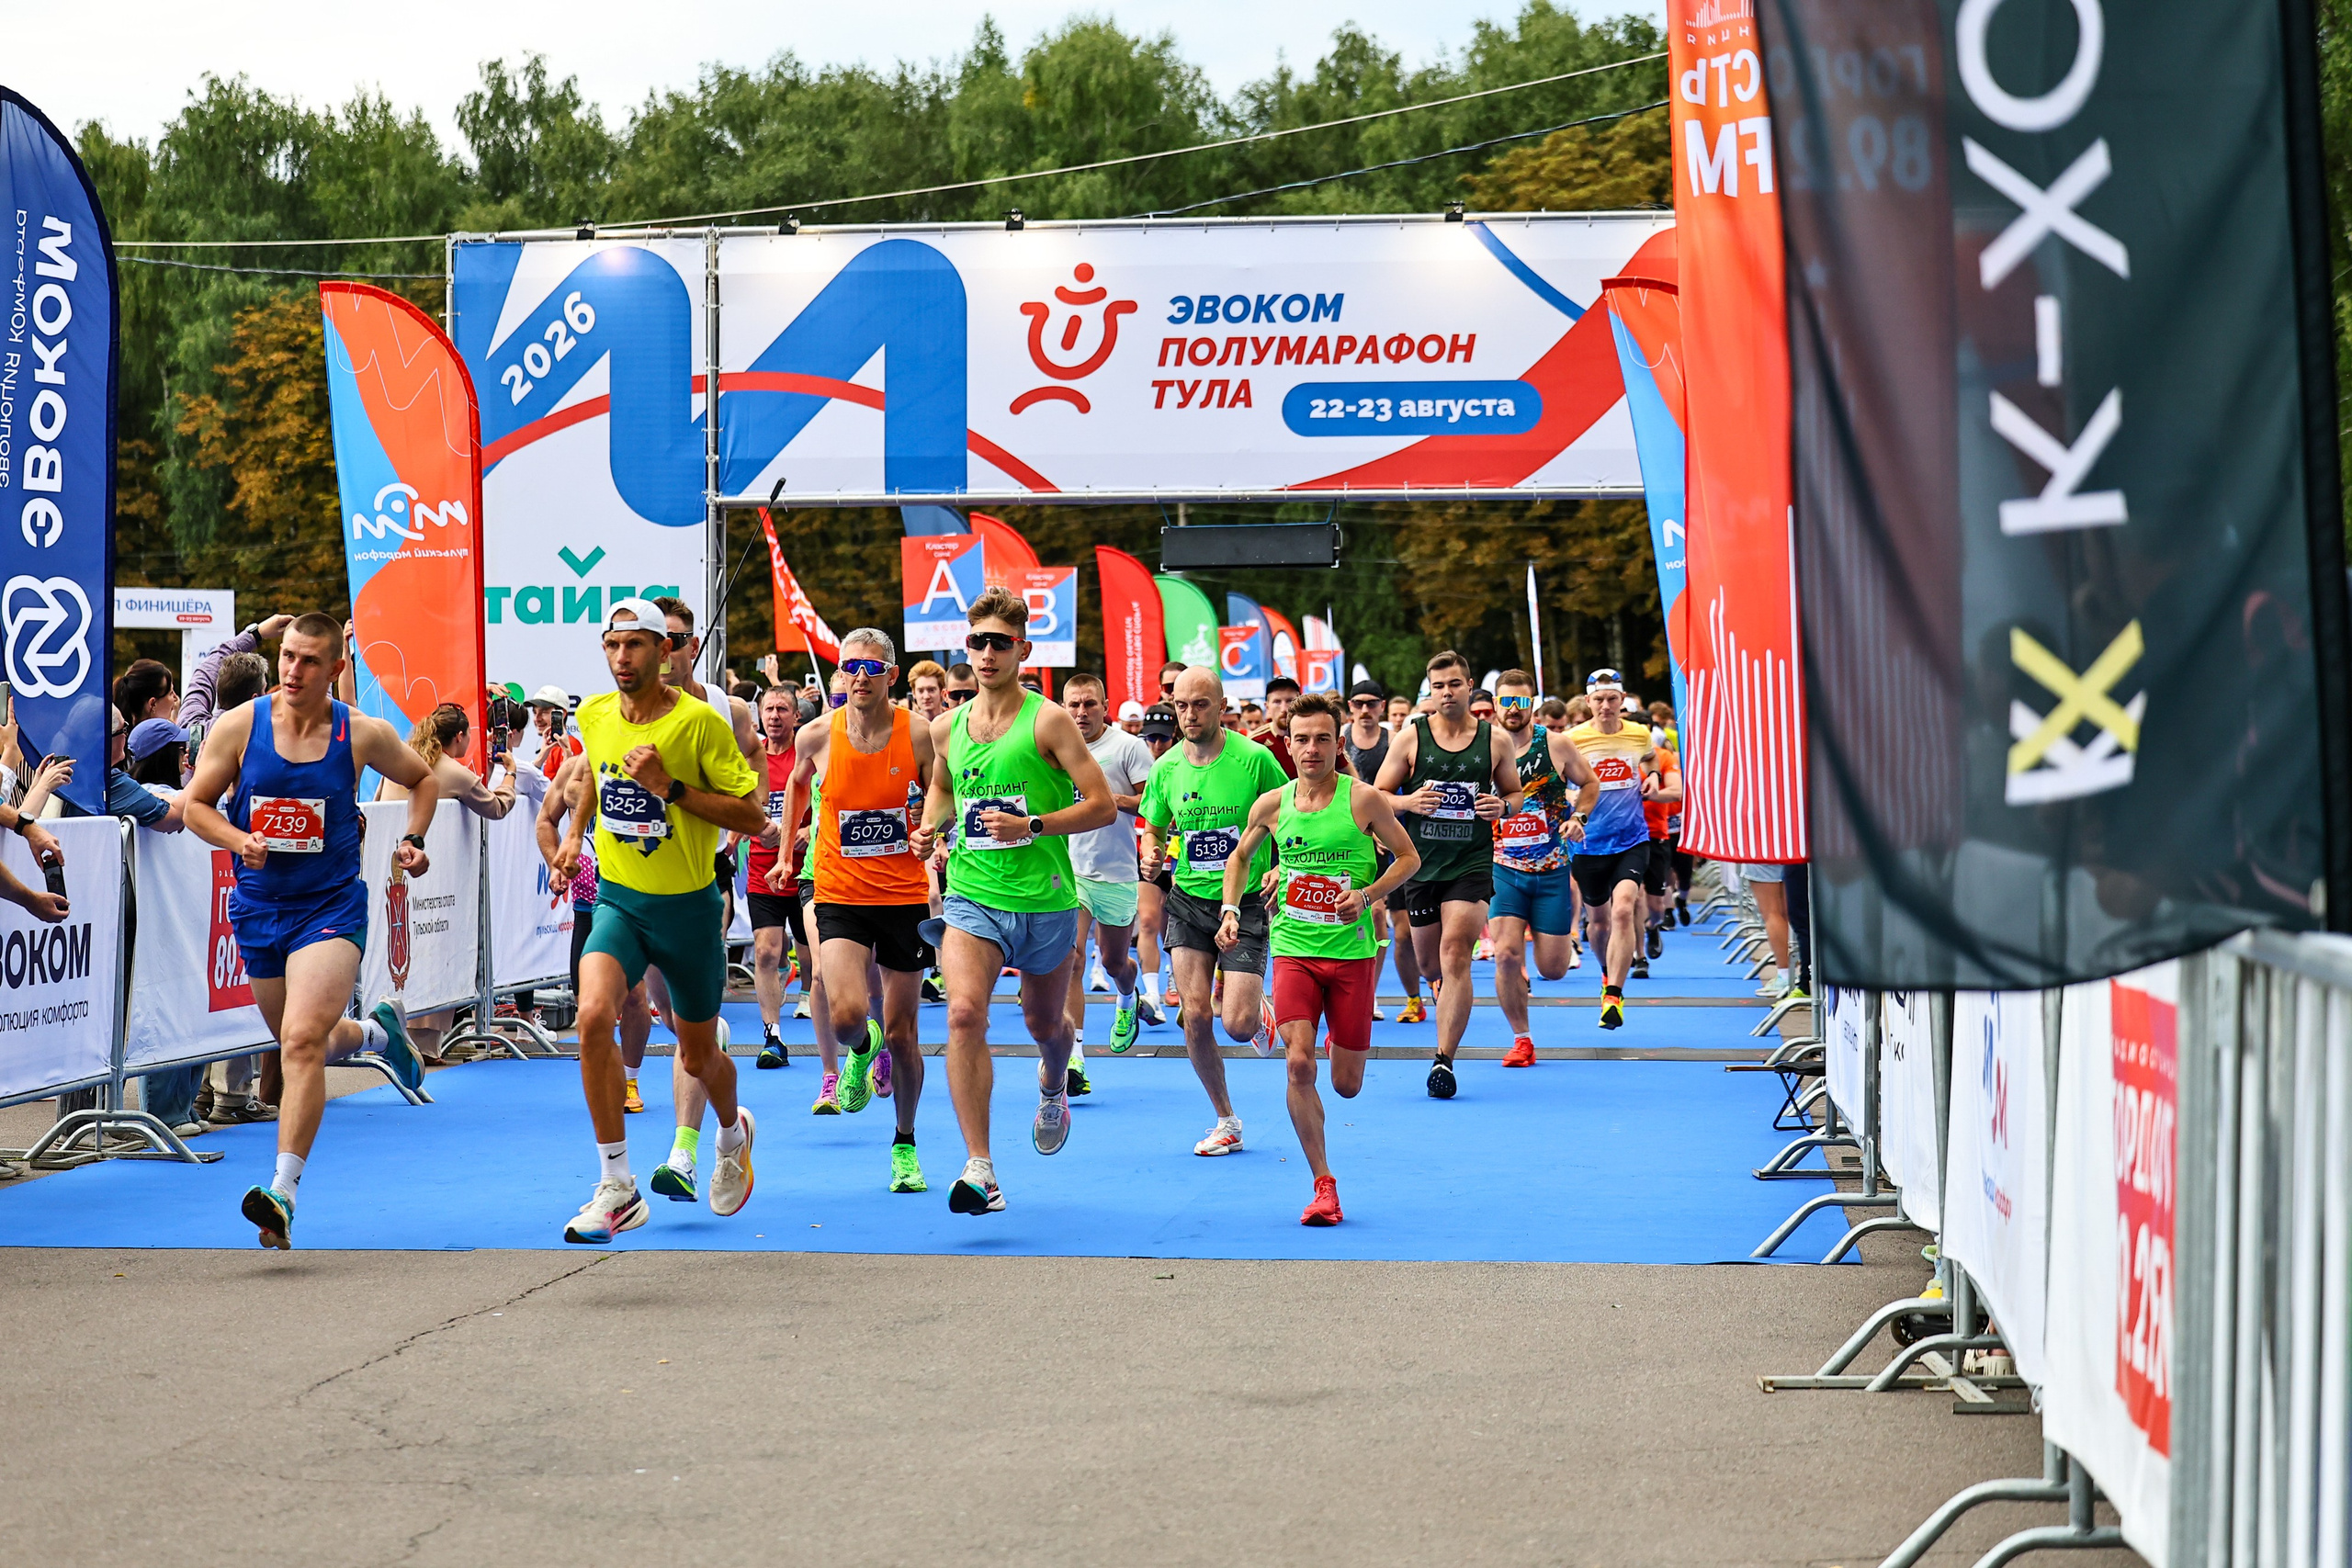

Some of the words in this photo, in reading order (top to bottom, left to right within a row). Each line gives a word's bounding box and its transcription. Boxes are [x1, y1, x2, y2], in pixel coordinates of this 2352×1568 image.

[1166, 293, 1345, 324] ЭВОКОМ
[500, 290, 596, 407] 2026
[1158, 333, 1477, 367] ПОЛУМАРАФОН
[1150, 379, 1253, 410] ТУЛА
[1308, 399, 1393, 423] 22-23
[1399, 398, 1516, 423] августа
[125, 598, 212, 614] ФИНИШЁРА
[1599, 766, 1625, 779] 7227
[605, 795, 647, 815] 5252
[1178, 806, 1240, 818] К-ХОЛДИНГ
[262, 814, 308, 833] 7139
[850, 824, 893, 841] 5079
[1509, 821, 1537, 834] 7001
[1195, 840, 1228, 857] 5138
[1283, 850, 1352, 864] К-ХОЛДИНГ
[1295, 886, 1336, 905] 7108
[0, 923, 92, 989] ОКОМ
[42, 999, 88, 1028] комфорта
